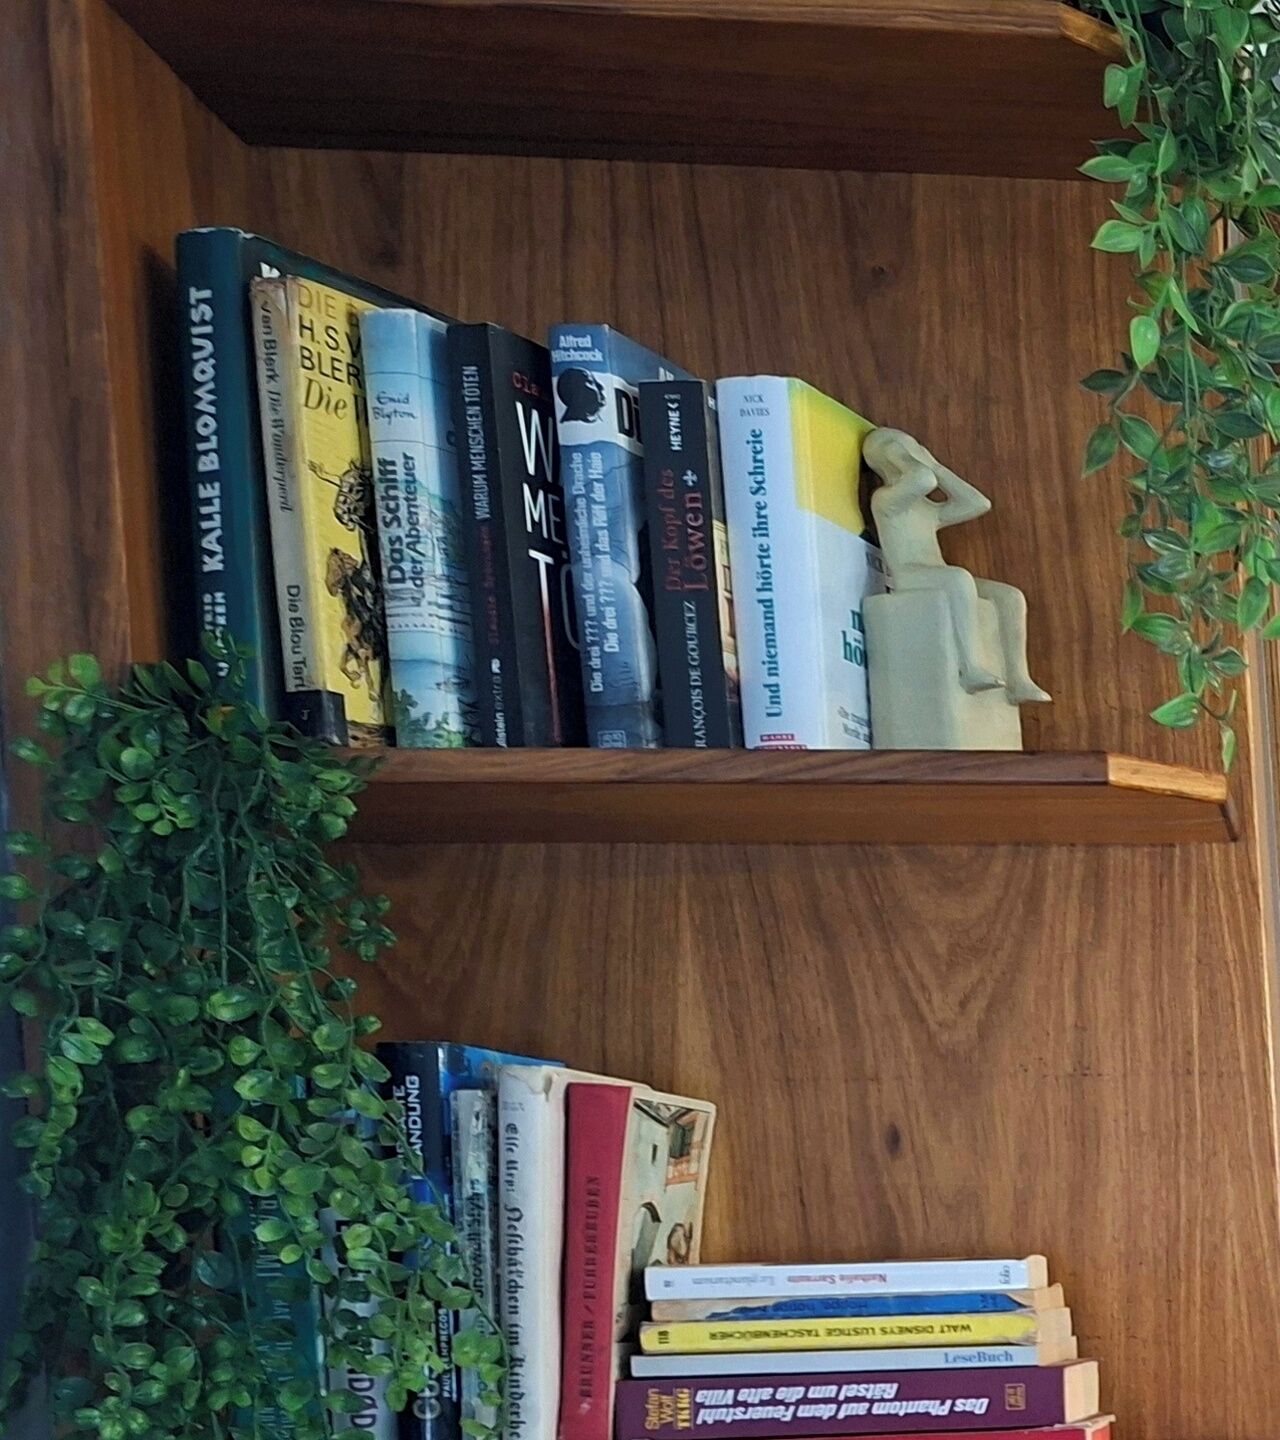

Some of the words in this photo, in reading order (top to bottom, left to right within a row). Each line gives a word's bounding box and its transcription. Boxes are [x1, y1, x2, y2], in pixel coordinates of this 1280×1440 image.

[298, 284, 337, 320] DIE
[559, 335, 591, 348] Alfred
[300, 345, 362, 389] BLER
[551, 349, 603, 362] Hitchcock
[189, 286, 221, 472] BLOMQUIST
[462, 365, 480, 402] TÖTEN
[304, 378, 348, 420] Die
[376, 391, 409, 405] Enid
[373, 405, 417, 425] Blyton
[614, 388, 643, 444] Di
[465, 406, 486, 475] MENSCHEN
[668, 409, 682, 451] HEYNE
[571, 452, 586, 495] Drache
[588, 452, 604, 479] Haie
[746, 428, 767, 496] Schreie
[377, 457, 402, 529] Schiff
[589, 483, 606, 503] der
[658, 468, 674, 499] des
[403, 452, 426, 557] Abenteuer
[473, 476, 491, 520] WARUM
[198, 481, 225, 573] KALLE
[752, 501, 770, 538] ihre
[596, 528, 611, 555] das
[388, 533, 406, 584] Das
[598, 556, 612, 578] und
[755, 543, 774, 592] hörte
[411, 563, 425, 588] der
[581, 577, 595, 597] der
[598, 581, 615, 604] ???
[583, 599, 596, 617] und
[600, 606, 617, 631] drei
[289, 614, 307, 655] Blou
[584, 621, 599, 643] ???
[604, 632, 619, 652] Die
[757, 599, 780, 678] niemand
[587, 650, 602, 673] drei
[590, 674, 603, 692] Die
[688, 666, 703, 686] DE
[763, 683, 782, 718] Und
[689, 687, 708, 748] RANÇOIS
[507, 1323, 523, 1346] im
[708, 1328, 821, 1341] TASCHENBÜCHER
[824, 1326, 877, 1337] LUSTIGE
[880, 1324, 936, 1336] DISNEYS
[939, 1323, 973, 1334] WALT
[578, 1320, 594, 1398] BRUNNER
[944, 1350, 1014, 1364] LeseBuch
[694, 1389, 735, 1407] Villa
[736, 1388, 773, 1405] alte
[774, 1386, 807, 1402] die
[806, 1384, 838, 1399] um
[838, 1383, 899, 1400] Rätsel
[645, 1388, 660, 1430] Stefan
[659, 1394, 675, 1424] Wolf
[696, 1405, 796, 1425] Feuerstuhl
[796, 1404, 837, 1420] dem
[836, 1402, 871, 1419] auf
[871, 1399, 953, 1416] Phantom
[953, 1398, 990, 1415] Das
